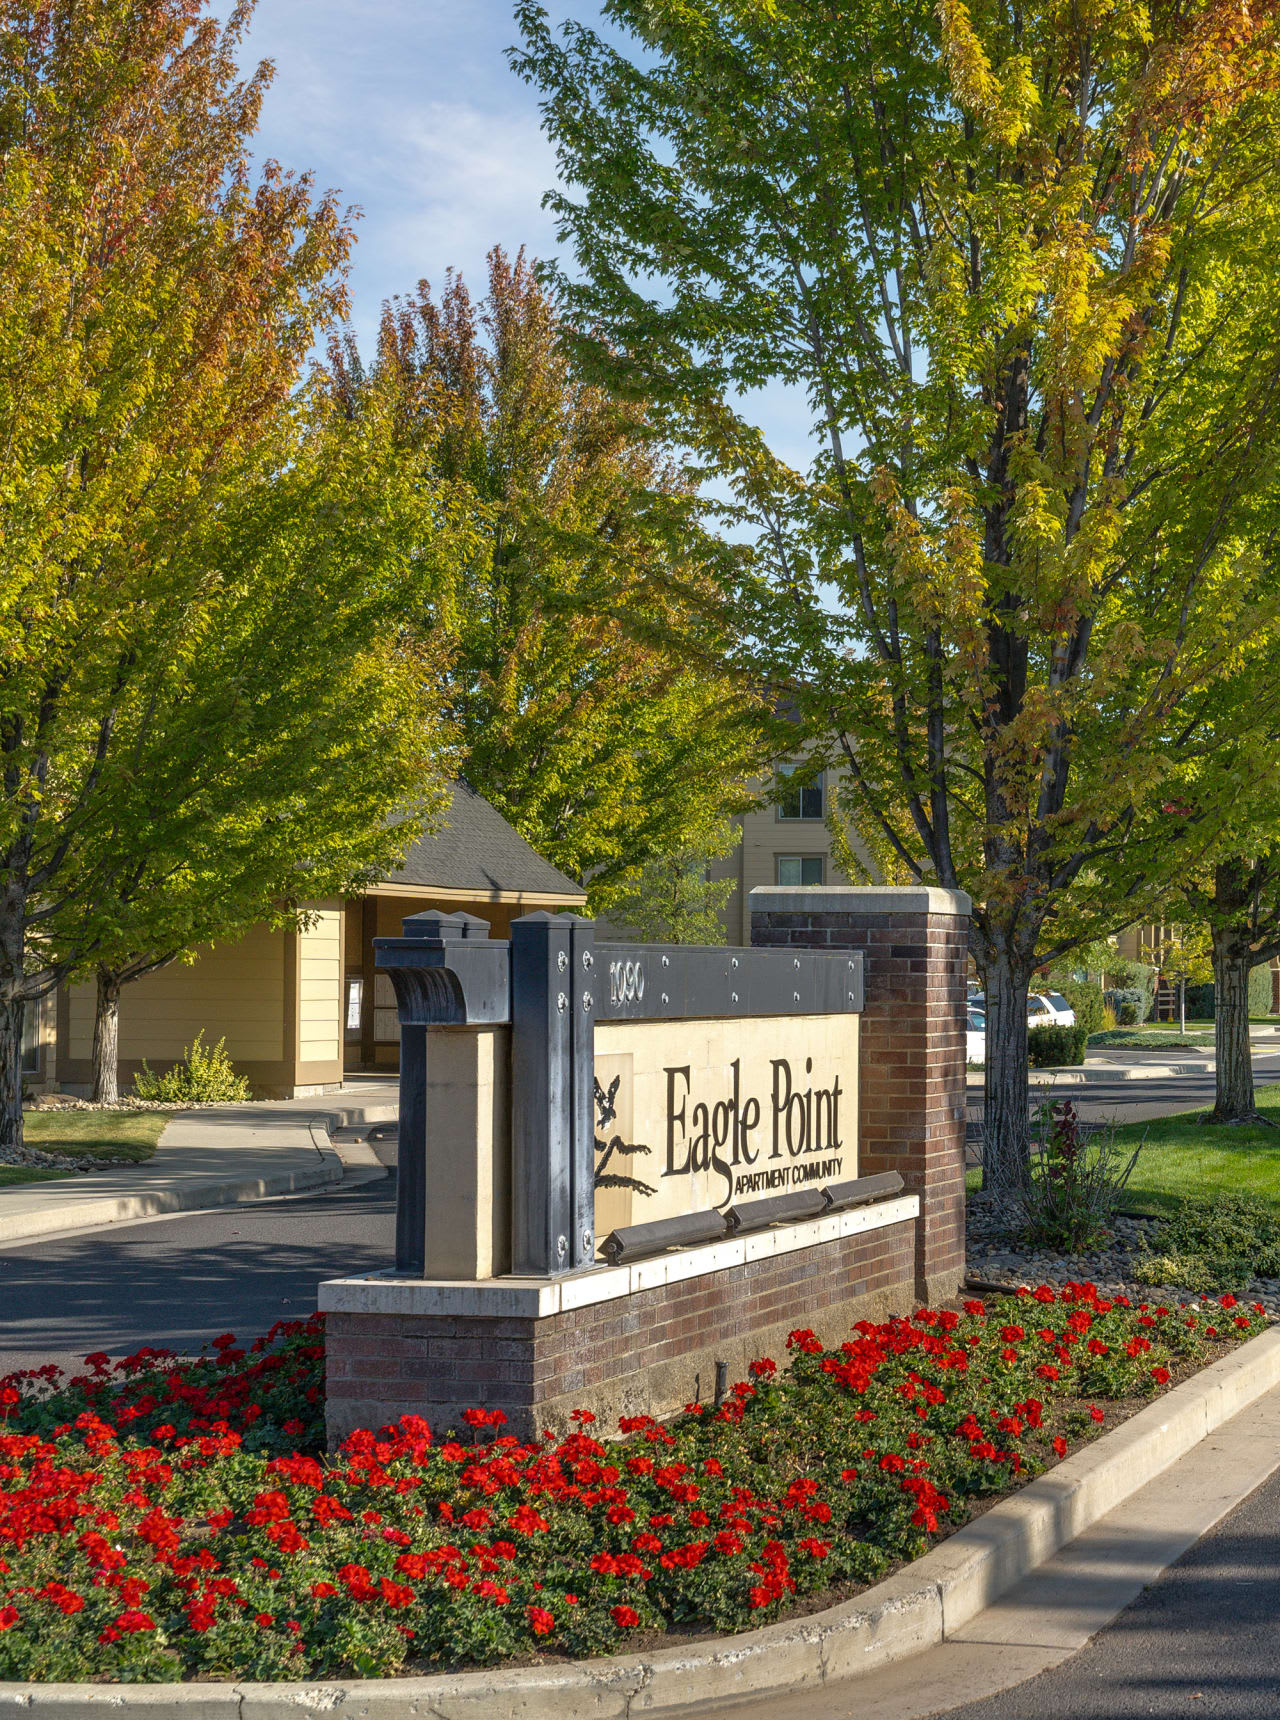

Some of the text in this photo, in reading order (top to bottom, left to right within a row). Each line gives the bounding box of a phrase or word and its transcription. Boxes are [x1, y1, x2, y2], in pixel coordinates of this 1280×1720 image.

[609, 960, 645, 1002] 1090
[661, 1056, 843, 1209] Eagle Point
[734, 1157, 843, 1196] APARTMENT COMMUNITY
